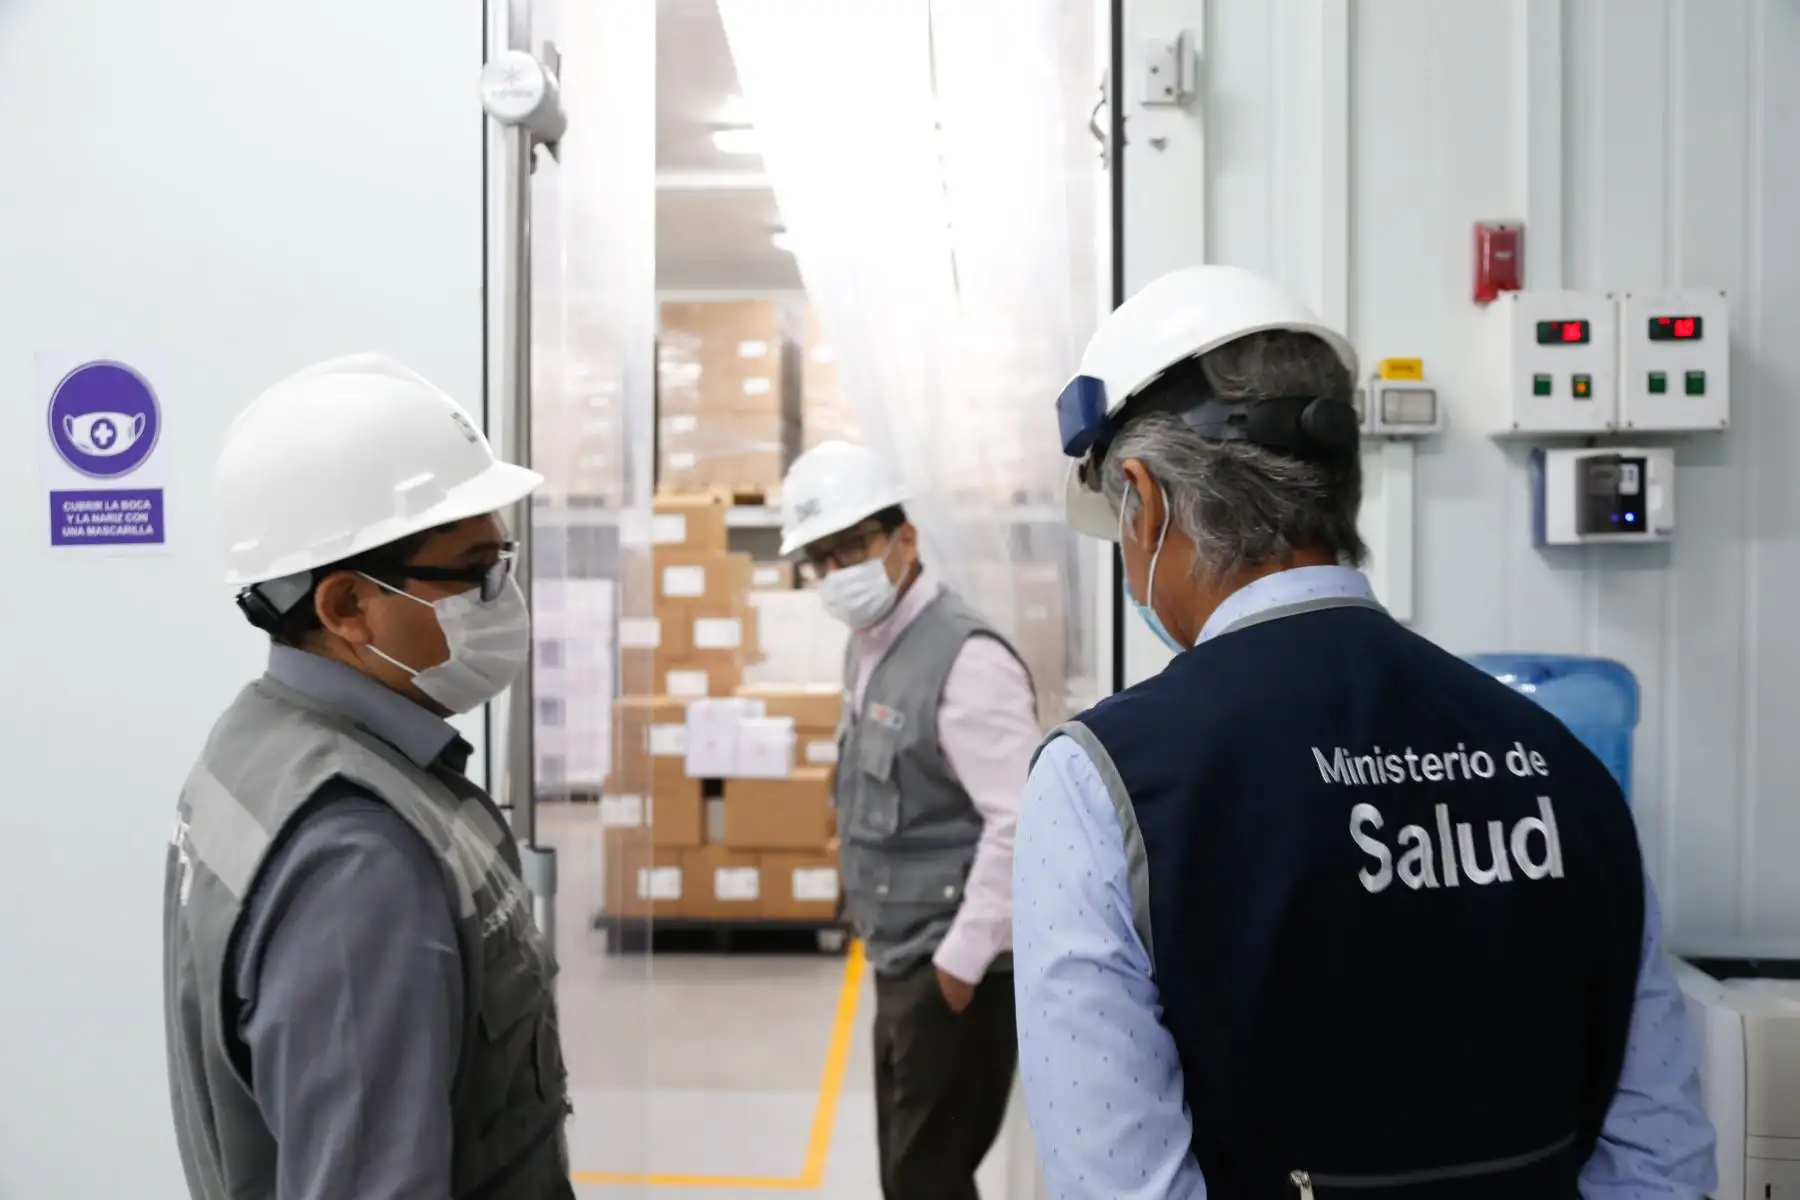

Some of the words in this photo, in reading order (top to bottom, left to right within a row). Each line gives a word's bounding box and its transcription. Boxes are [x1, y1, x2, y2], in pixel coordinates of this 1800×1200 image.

[63, 500, 103, 512] CUBRIR
[104, 500, 120, 511] LA
[121, 499, 152, 511] BOCA
[66, 513, 75, 524] Y
[75, 513, 90, 524] LA
[91, 512, 124, 523] NARIZ
[124, 511, 149, 523] CON
[62, 525, 86, 537] UNA
[86, 524, 154, 536] MASCARILLA
[1311, 742, 1496, 785] Ministerio
[1505, 741, 1550, 777] de
[1349, 795, 1565, 893] Salud
